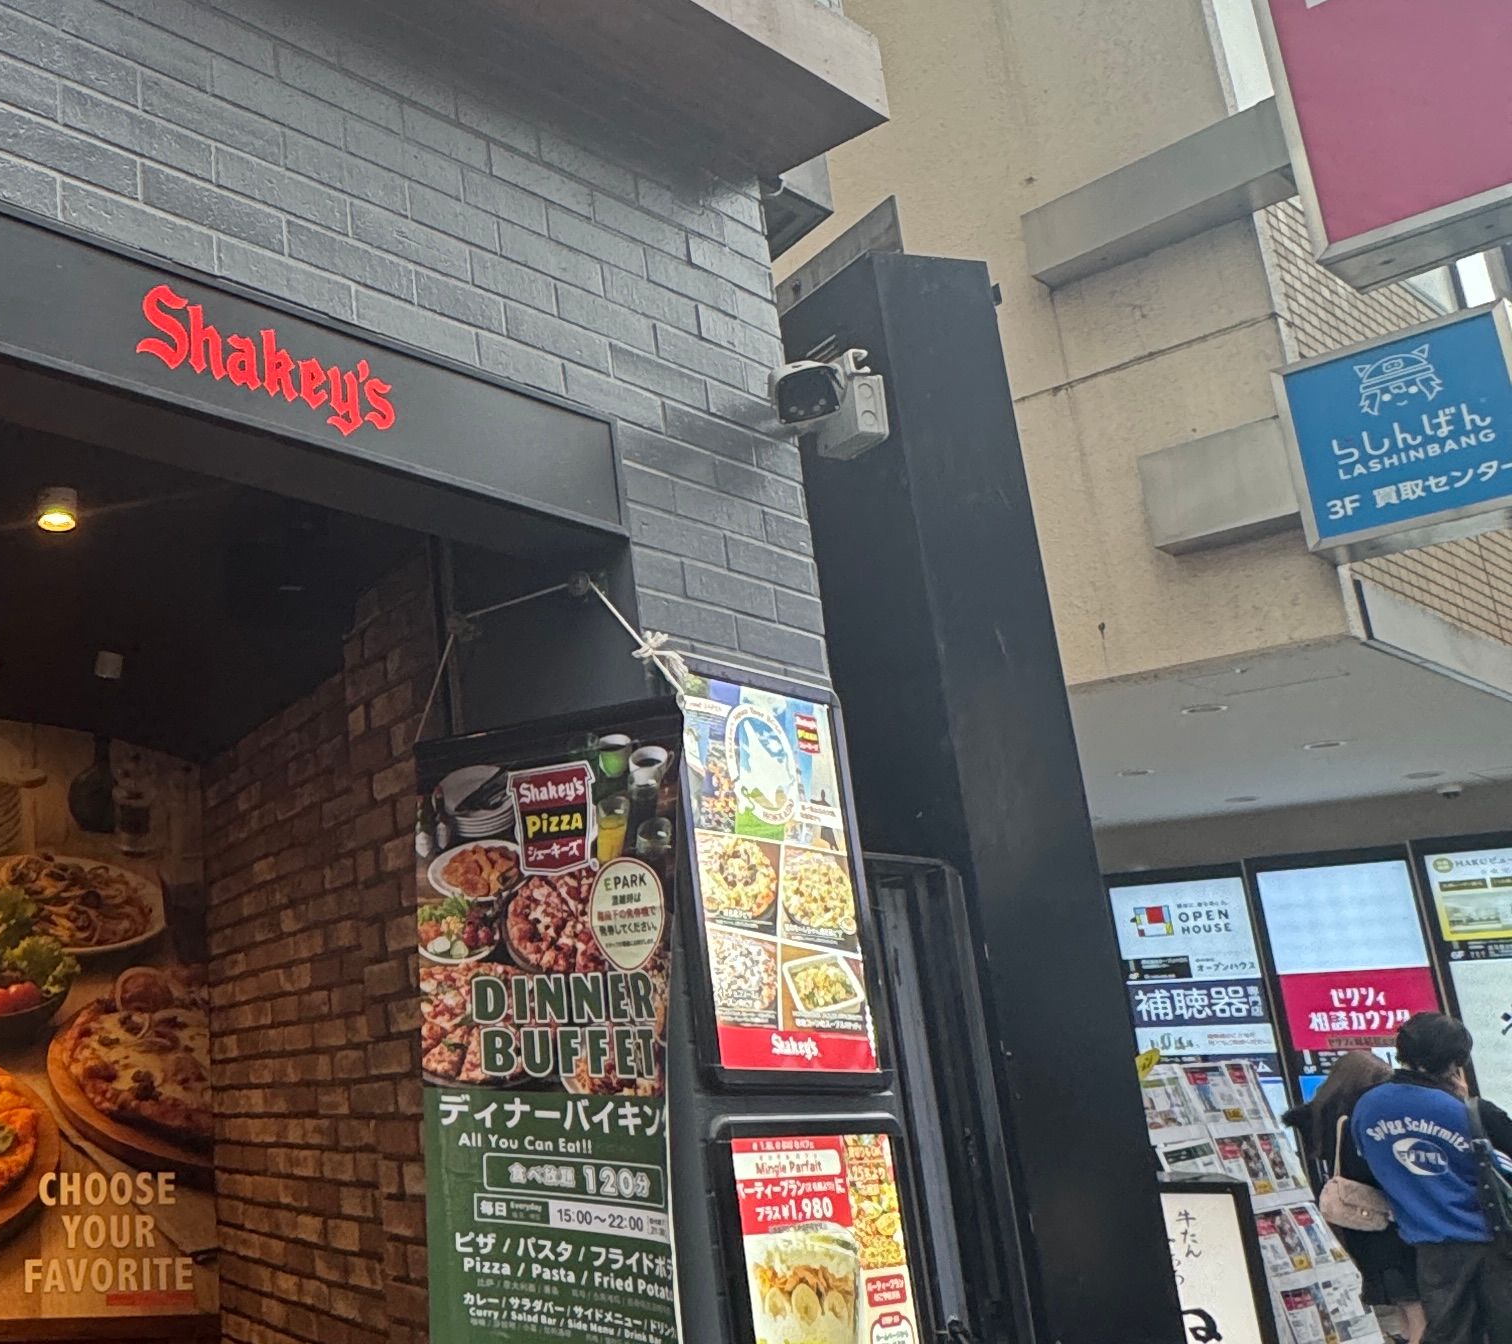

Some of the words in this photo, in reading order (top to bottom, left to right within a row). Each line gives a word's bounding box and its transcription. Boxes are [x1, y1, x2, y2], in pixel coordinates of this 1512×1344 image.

[136, 284, 396, 436] Shakey's
[1331, 403, 1492, 465] らしんばん
[1338, 428, 1496, 481] LASHINBANG
[1325, 494, 1361, 520] 3F
[1372, 459, 1512, 509] 買取センター
[519, 776, 585, 804] Shakey's
[1178, 908, 1230, 923] OPEN
[1181, 922, 1233, 935] HOUSE
[1197, 961, 1256, 973] オープンハウス
[471, 971, 657, 1025] DINNER
[1134, 985, 1250, 1022] 補聴器
[1329, 986, 1387, 1007] ゼクシィ
[479, 1025, 657, 1079] BUFFET
[771, 1033, 819, 1060] Shakey's
[439, 1094, 667, 1137] ディナーバイキン
[458, 1132, 482, 1147] All
[488, 1134, 519, 1149] You
[524, 1136, 553, 1152] Can
[558, 1137, 592, 1154] Eat!!
[1403, 1116, 1470, 1153] Schirmitz
[38, 1171, 176, 1206] CHOOSE
[582, 1165, 651, 1199] 120分
[61, 1214, 156, 1249] YOUR
[454, 1232, 497, 1255] ピザ
[516, 1237, 573, 1263] パスタ
[1176, 1209, 1202, 1258] 牛たん
[24, 1257, 194, 1294] FAVORITE
[463, 1258, 512, 1276] Pizza
[531, 1263, 576, 1284] Pasta
[593, 1272, 634, 1293] Fried
[463, 1292, 500, 1307] カレー
[469, 1307, 499, 1320] Curry
[567, 1319, 589, 1331] Side
[624, 1329, 648, 1343] Drink
